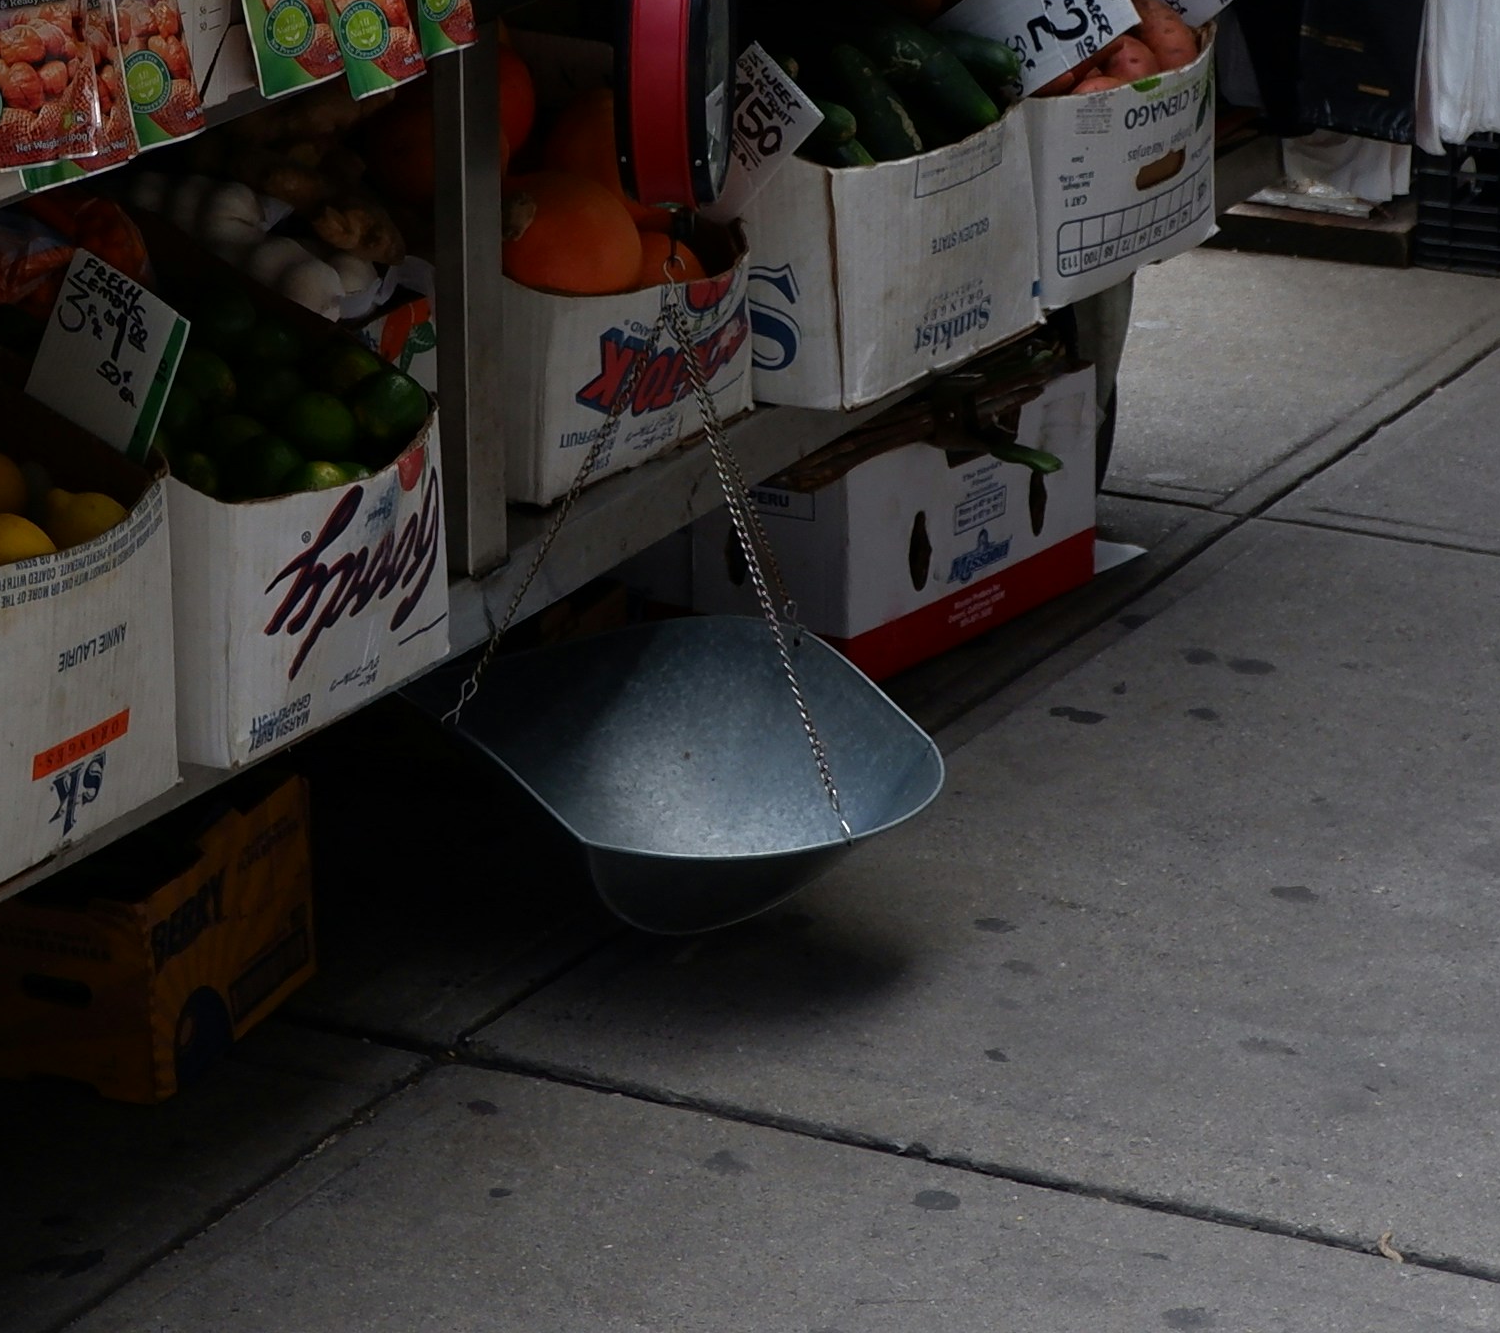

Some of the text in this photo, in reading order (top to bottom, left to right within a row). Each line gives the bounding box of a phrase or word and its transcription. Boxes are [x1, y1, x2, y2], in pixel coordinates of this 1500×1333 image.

[747, 50, 803, 111] SWEET
[1124, 86, 1190, 132] CIENAGO
[83, 258, 144, 301] FRESH
[913, 295, 992, 356] Sunkist
[57, 621, 128, 673] ANNIE LAURIE
